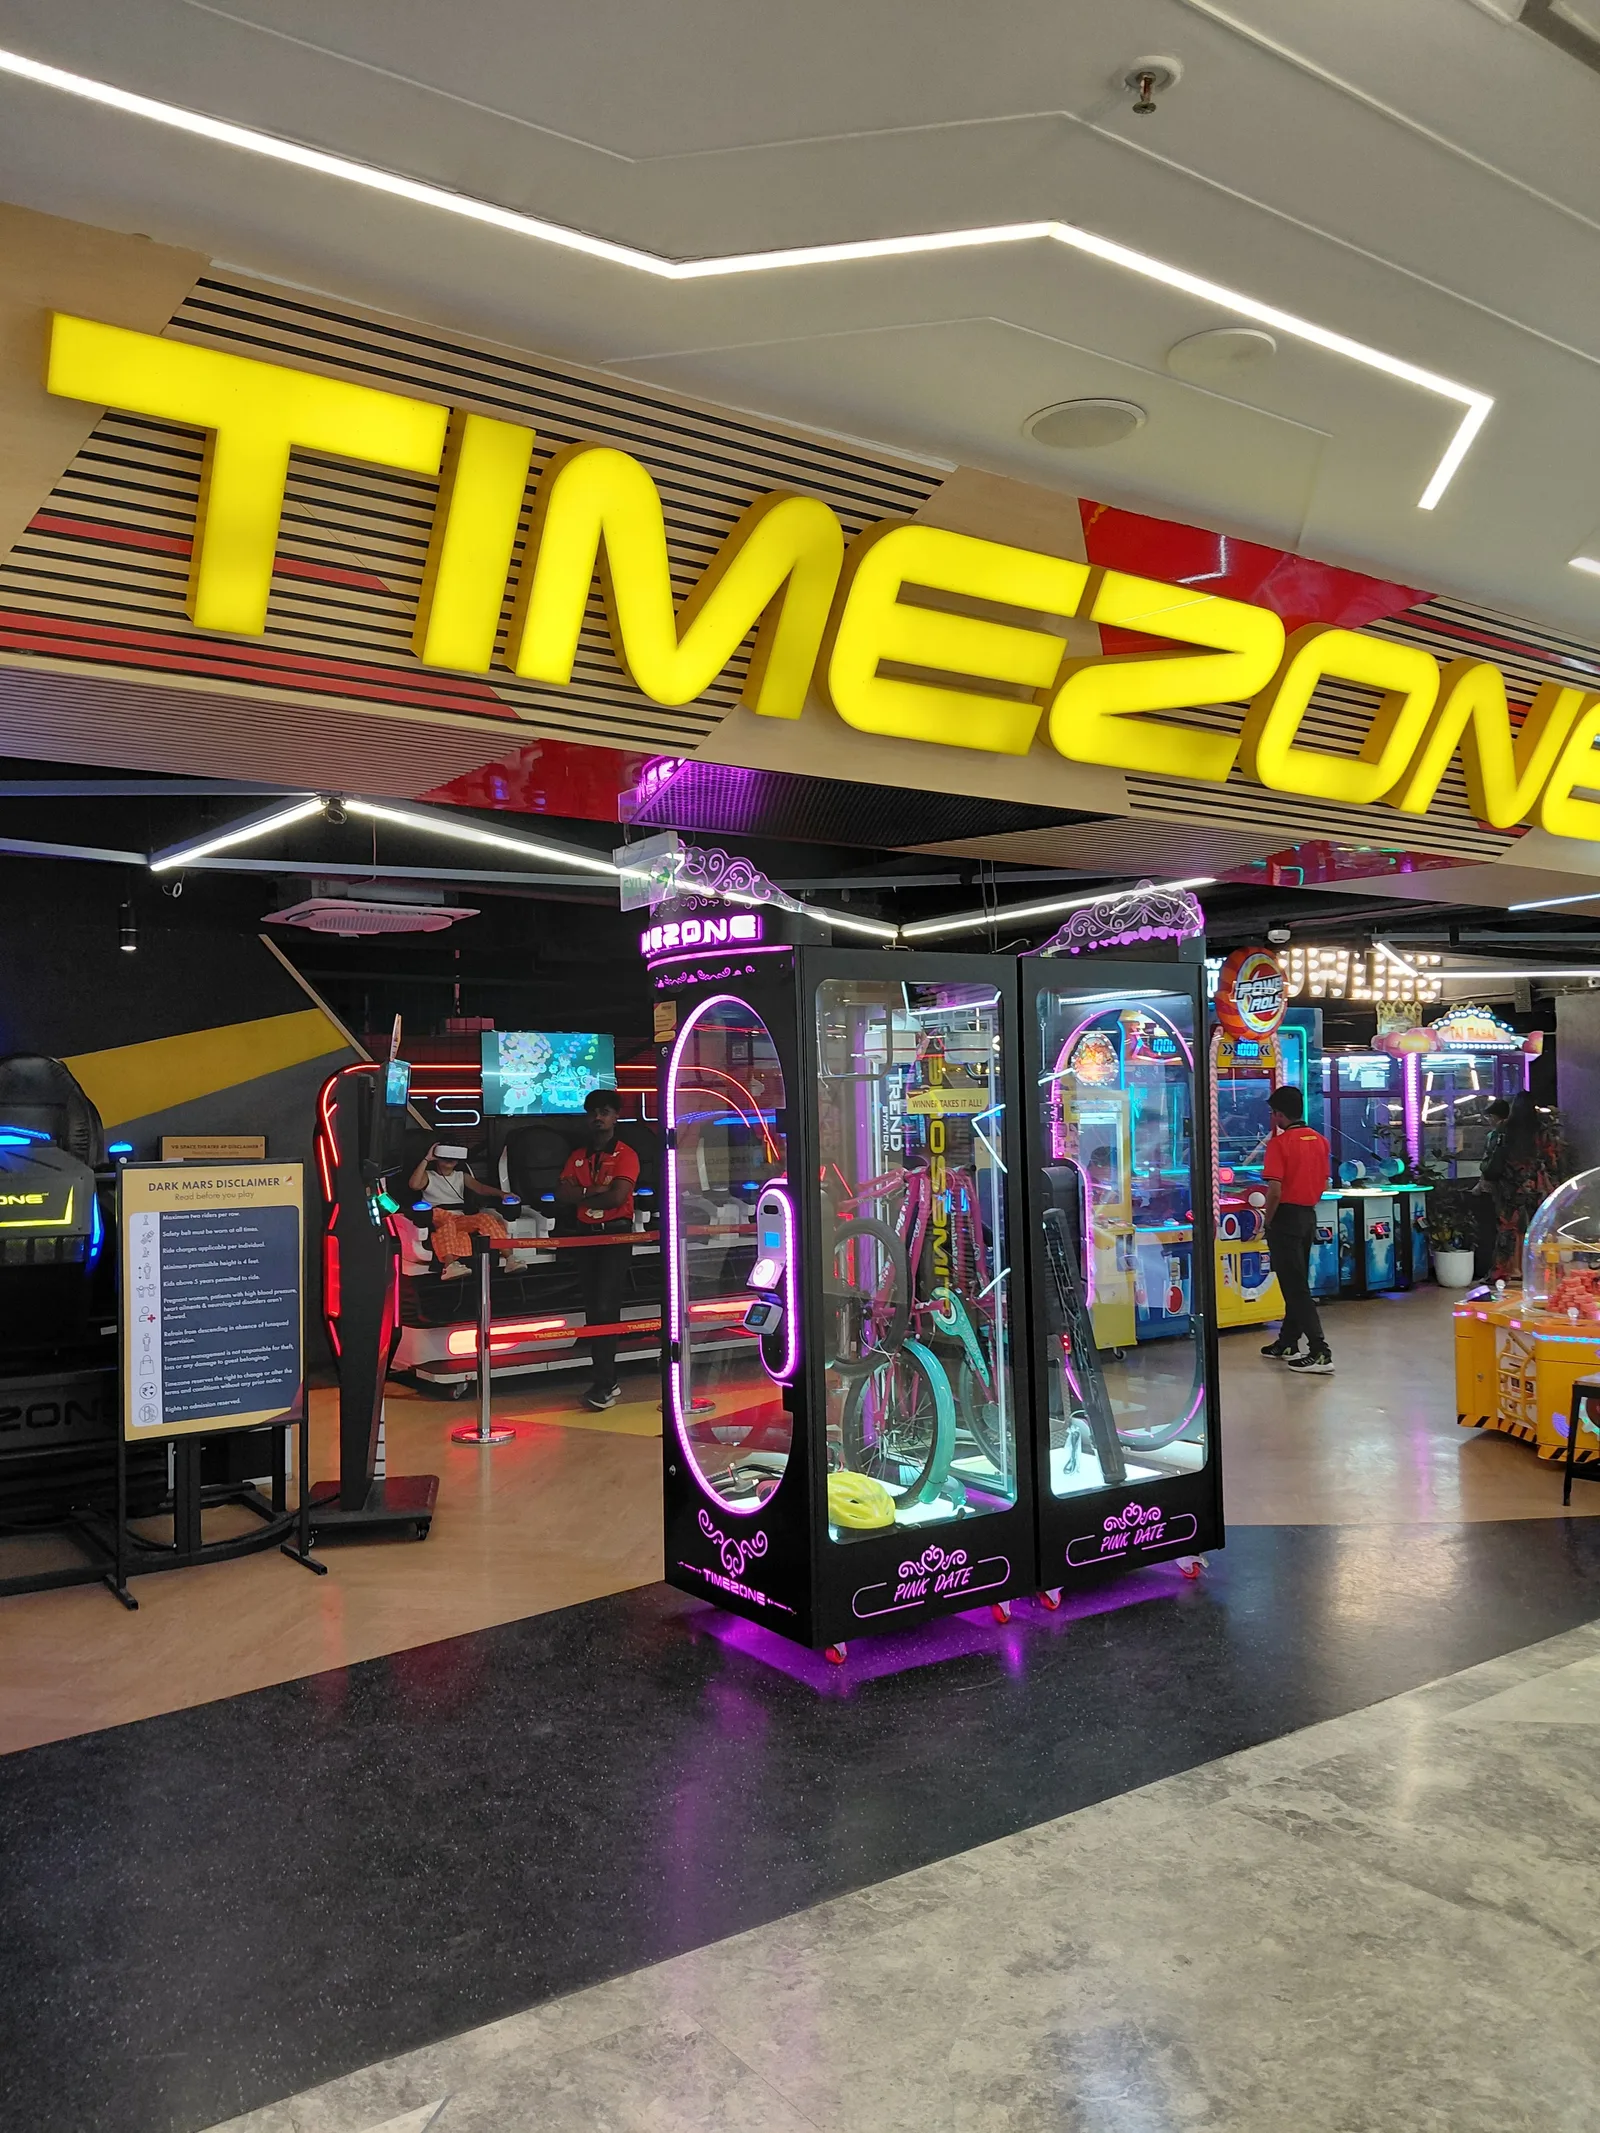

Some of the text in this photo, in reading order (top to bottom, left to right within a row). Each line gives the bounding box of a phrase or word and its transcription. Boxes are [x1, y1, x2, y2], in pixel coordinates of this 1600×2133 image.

[46, 311, 1600, 842] TIMEZONE
[1237, 1043, 1259, 1057] 1000
[940, 1100, 960, 1108] TAKES
[968, 1099, 982, 1107] ALL!
[888, 1068, 903, 1151] TREND
[148, 1177, 280, 1192] DARK MARS DISCLAIMER
[174, 1193, 195, 1201] Read
[196, 1191, 221, 1199] before
[237, 1190, 255, 1199] play
[175, 1246, 197, 1254] charges
[198, 1244, 227, 1252] applicable
[188, 1261, 219, 1269] permissible
[215, 1276, 241, 1284] permitted
[164, 1296, 187, 1305] Pregnant
[210, 1293, 232, 1301] patients
[179, 1303, 201, 1311] ailments
[207, 1300, 241, 1308] neurological
[197, 1326, 229, 1334] descending
[627, 1321, 661, 1330] TIMEZON
[534, 1330, 576, 1339] TIMEZONE
[190, 1351, 226, 1359] management
[241, 1346, 271, 1355] responsible
[194, 1360, 217, 1368] damage
[243, 1371, 263, 1379] change
[192, 1385, 220, 1393] conditions
[252, 1379, 265, 1387] prior
[189, 1402, 216, 1410] admission
[1100, 1522, 1167, 1553] PINK DATE
[703, 1568, 766, 1606] TIMEZONE
[894, 1566, 974, 1602] PINK DATE
